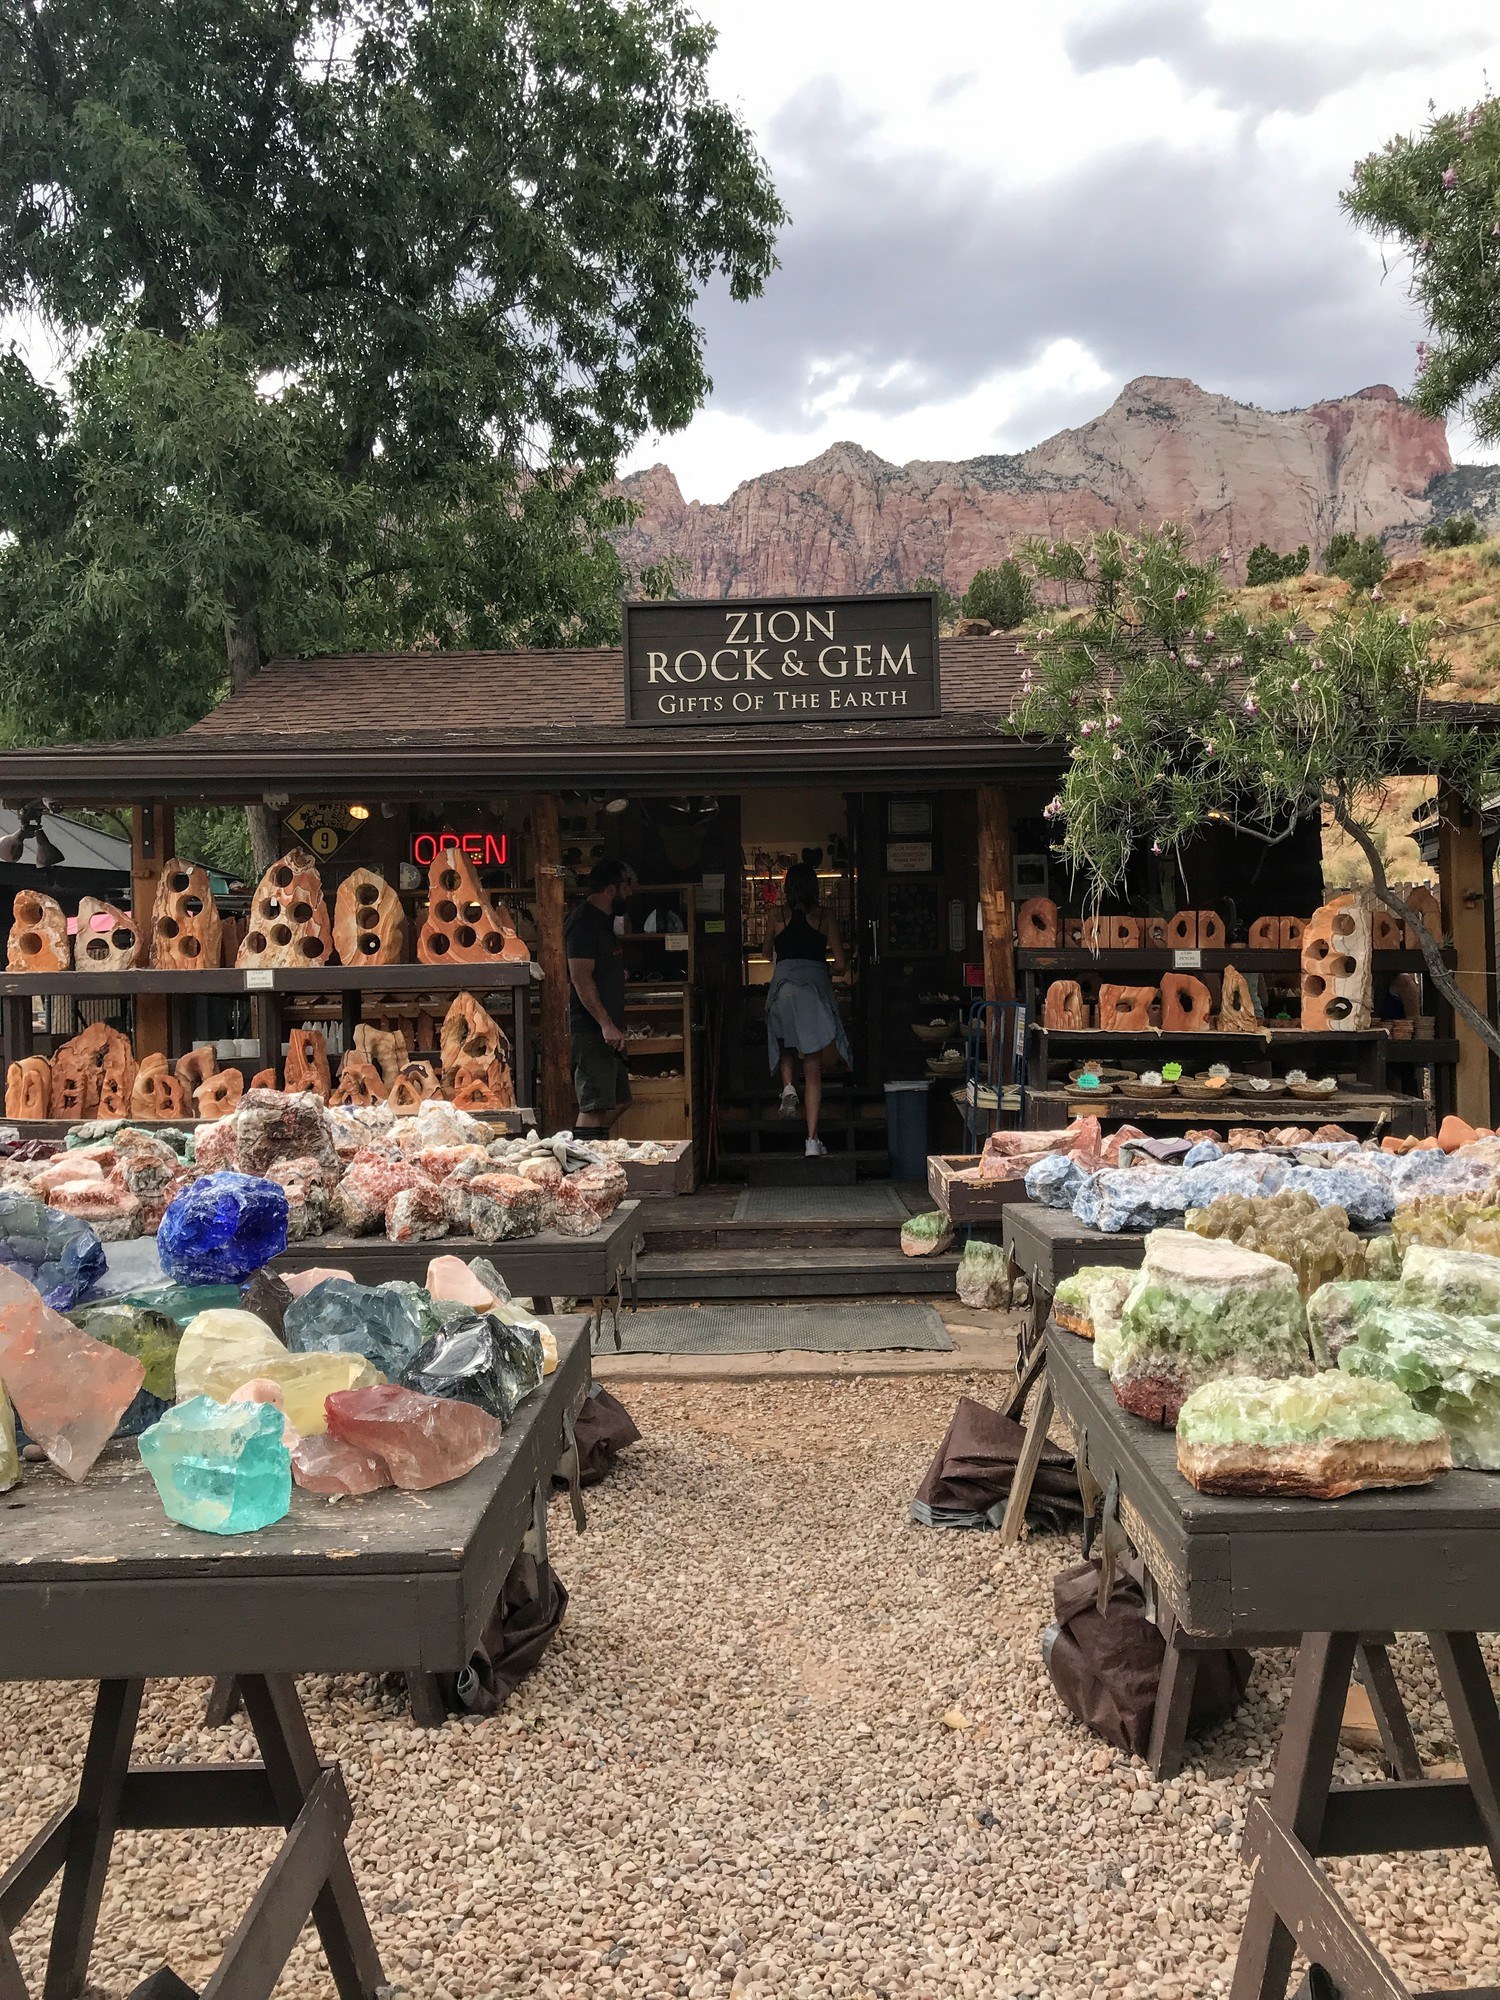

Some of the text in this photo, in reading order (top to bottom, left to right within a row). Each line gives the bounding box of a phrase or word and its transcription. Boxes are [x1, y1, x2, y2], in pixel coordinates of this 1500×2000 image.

[725, 610, 835, 645] ZION
[647, 643, 917, 684] ROCK & GEM
[321, 832, 329, 849] 9
[414, 833, 507, 865] OPEN
